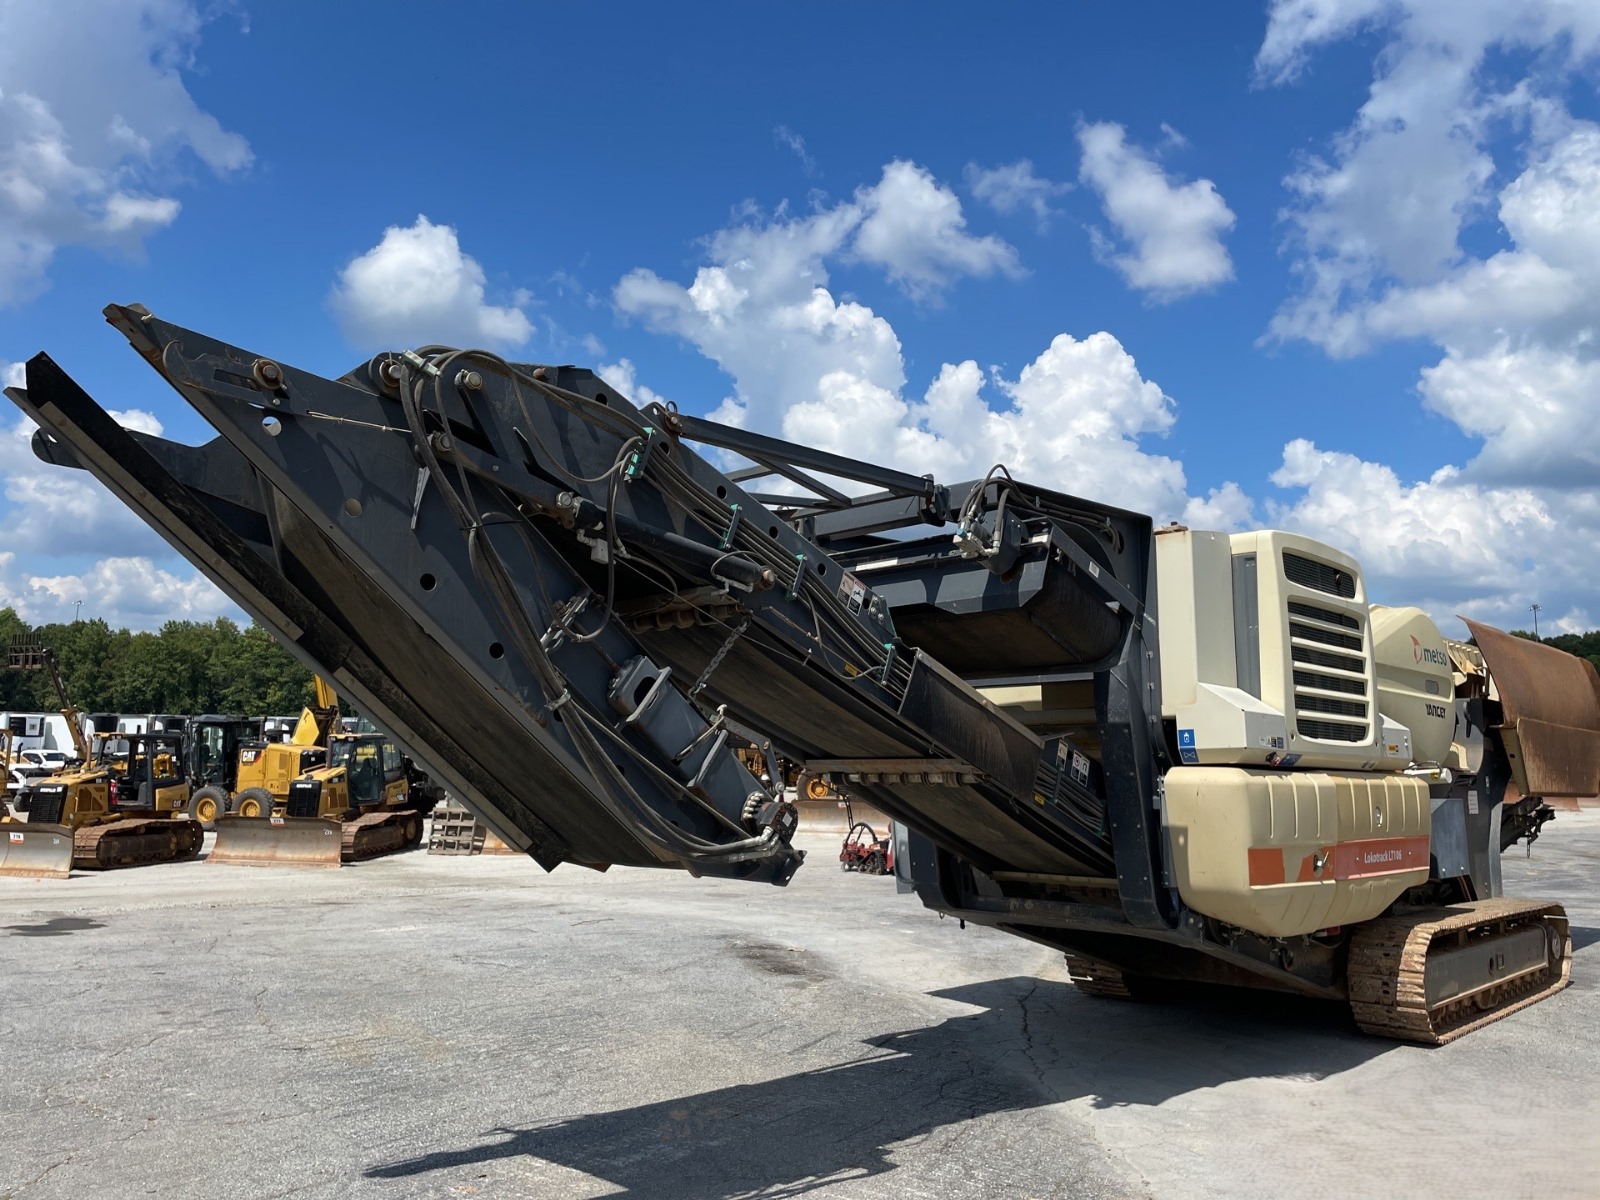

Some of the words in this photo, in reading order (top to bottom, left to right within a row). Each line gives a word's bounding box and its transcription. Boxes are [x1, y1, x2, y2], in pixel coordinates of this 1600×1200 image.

[1423, 647, 1447, 666] metso
[1425, 703, 1446, 719] YANCEY
[242, 750, 256, 762] CAT
[1364, 851, 1388, 864] Lokotrack
[1388, 849, 1403, 861] LT106
